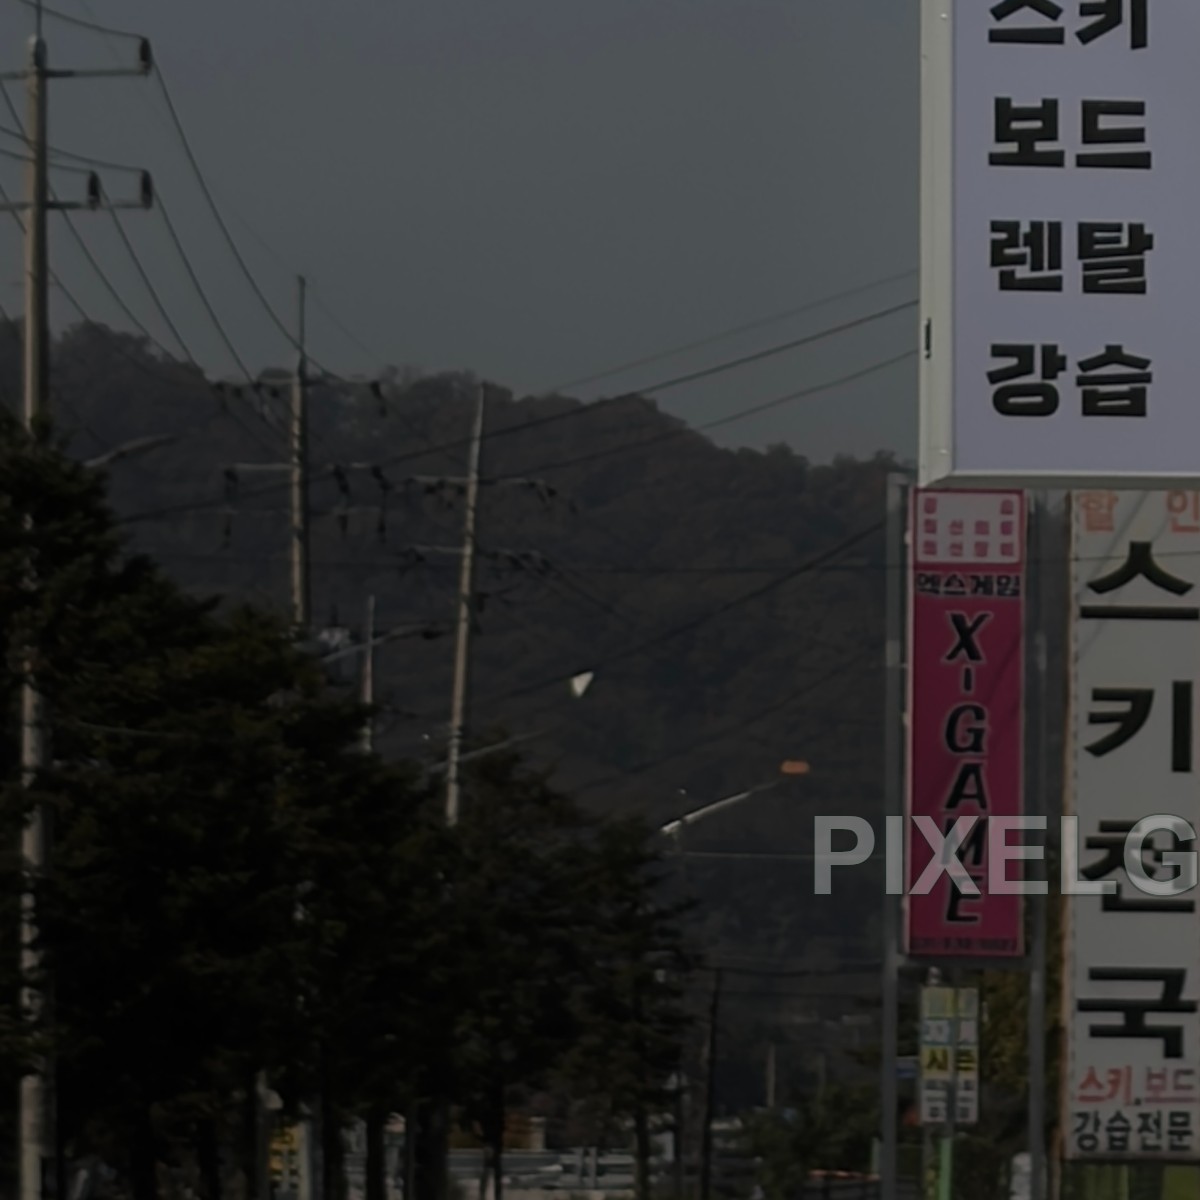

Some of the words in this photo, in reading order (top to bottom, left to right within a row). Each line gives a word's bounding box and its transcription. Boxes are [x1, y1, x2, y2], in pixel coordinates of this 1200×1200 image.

[988, 96, 1152, 169] 보드
[989, 219, 1154, 294] 렌탈
[986, 343, 1153, 418] 강습
[917, 573, 1020, 596] 엑스게임
[1077, 540, 1200, 1058] 스키천국
[1073, 1109, 1195, 1152] 강습전문
